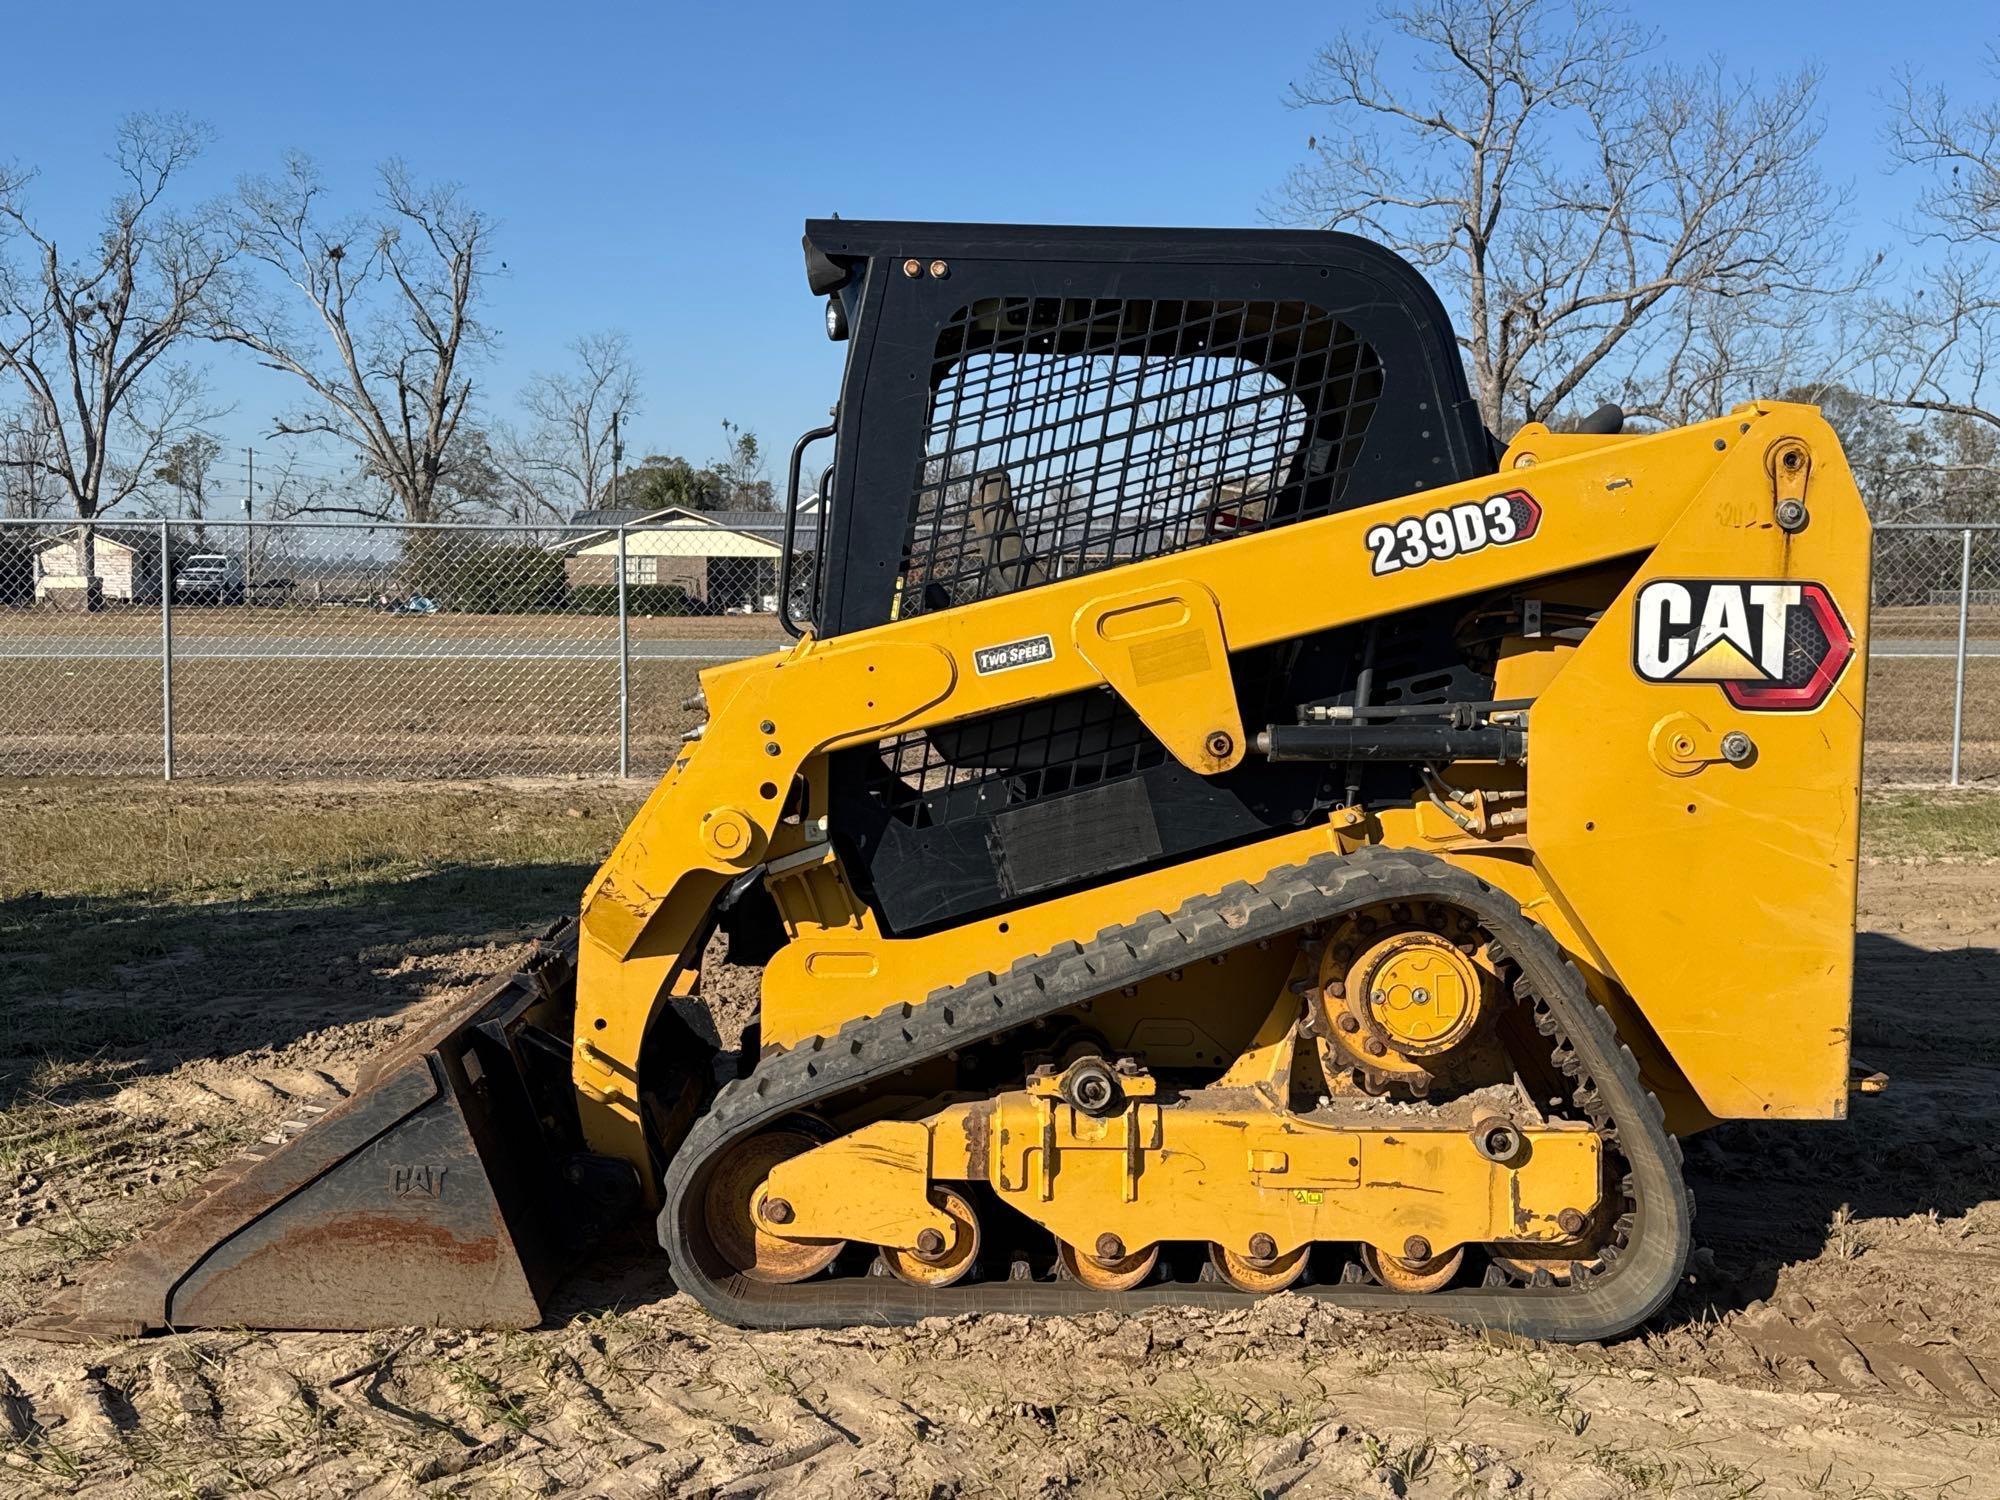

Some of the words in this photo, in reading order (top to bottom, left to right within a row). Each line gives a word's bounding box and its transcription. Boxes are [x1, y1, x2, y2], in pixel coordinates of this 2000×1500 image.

[1367, 496, 1517, 574] 239D3
[1637, 582, 1801, 680] CAT
[387, 1164, 448, 1200] CAT
